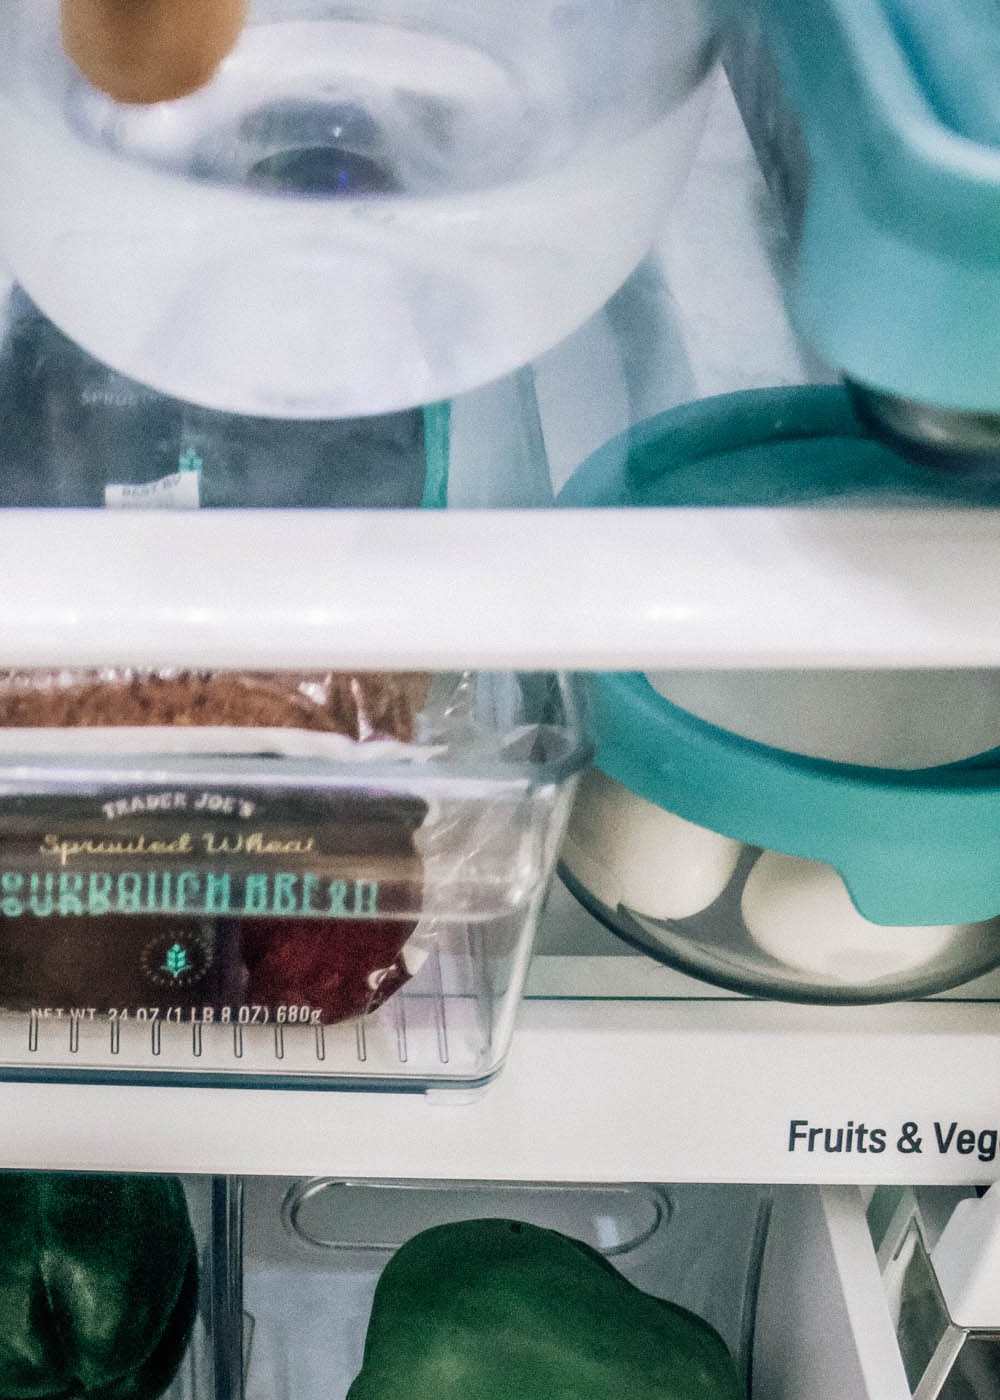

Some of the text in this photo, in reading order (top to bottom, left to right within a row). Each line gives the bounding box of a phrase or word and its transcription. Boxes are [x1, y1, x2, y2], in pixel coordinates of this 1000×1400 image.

[102, 793, 256, 819] TRADER JOE'S
[136, 1007, 160, 1022] OZ
[166, 1007, 182, 1024] (1
[191, 1007, 215, 1024] LB
[221, 1006, 231, 1024] 8
[238, 1006, 270, 1025] OZ)
[277, 1005, 323, 1025] 680g
[788, 1119, 1000, 1162] Fruits & Veg
